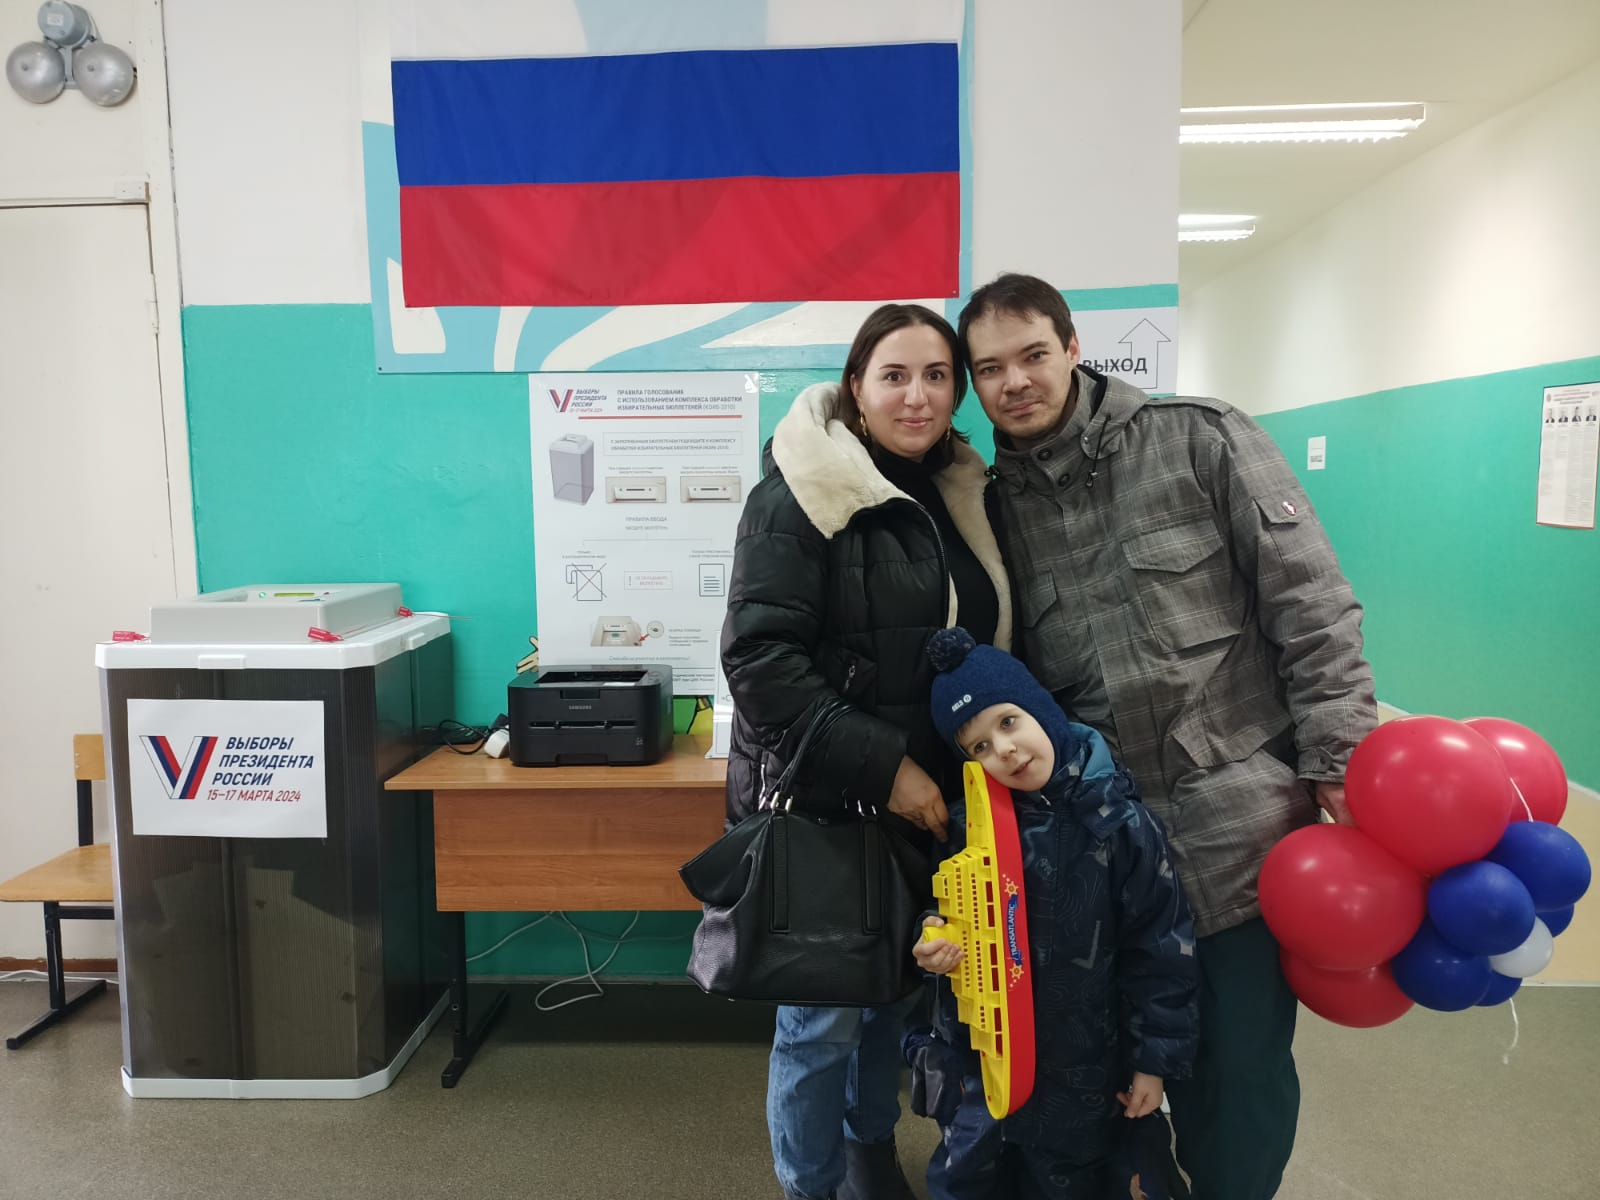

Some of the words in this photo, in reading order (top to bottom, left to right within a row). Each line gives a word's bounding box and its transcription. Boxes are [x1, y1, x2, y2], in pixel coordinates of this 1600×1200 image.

[225, 736, 295, 751] ВЫБОРЫ
[218, 754, 315, 770] ПРЕЗИДЕНТА
[211, 772, 274, 786] РОССИИ
[239, 789, 274, 802] МАРТА
[275, 790, 302, 803] 2024
[1008, 902, 1018, 957] TRANSATLANTIC
